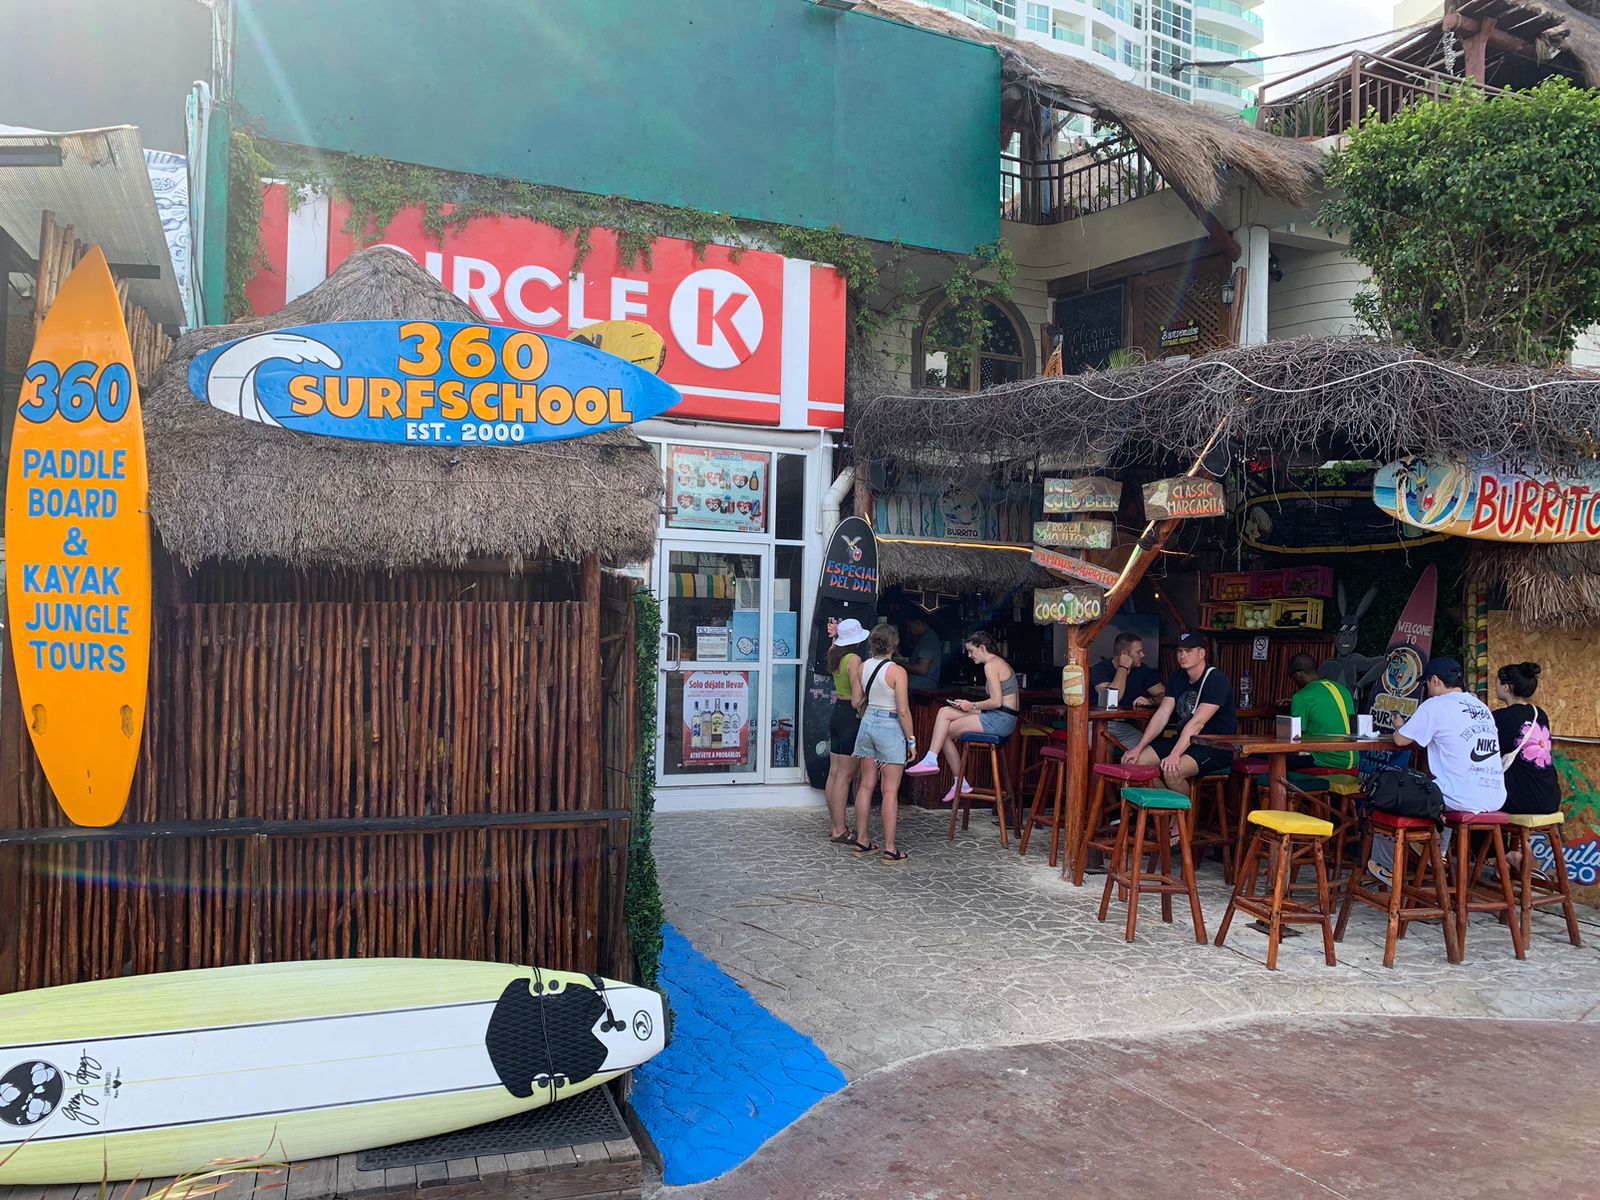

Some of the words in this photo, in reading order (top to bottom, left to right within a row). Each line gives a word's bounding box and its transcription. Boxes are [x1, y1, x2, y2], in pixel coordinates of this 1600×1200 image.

[366, 244, 649, 331] RCLE
[696, 286, 751, 366] K
[397, 321, 549, 381] 360
[18, 360, 131, 424] 360
[287, 375, 633, 425] SURFSCHOOL
[405, 422, 451, 441] EST.
[461, 422, 525, 442] 2000
[22, 449, 127, 480] PADDLE
[1048, 479, 1073, 493] ICE
[1172, 482, 1214, 499] CLASSIC
[28, 487, 118, 519] BOARD
[1044, 494, 1080, 508] COLD
[1084, 494, 1120, 508] BEER
[1167, 497, 1225, 516] MARGARITA
[946, 527, 979, 537] BURRITO
[1046, 521, 1080, 533] FROZEN
[62, 526, 89, 557] &
[826, 559, 877, 582] ESPECIAL
[1036, 551, 1073, 573] FAMOUS
[22, 564, 121, 595] KAYAK
[830, 573, 849, 590] DEL
[852, 578, 871, 593] DIA
[24, 603, 130, 635] JUNGLE
[1035, 602, 1066, 620] COCO
[1070, 600, 1100, 619] LOCO
[1398, 620, 1432, 637] WELCOME
[1406, 633, 1417, 645] TO
[29, 640, 126, 673] TOURS
[689, 680, 703, 689] Solo
[704, 680, 725, 690] déjate
[726, 680, 744, 689] llevar
[1375, 694, 1416, 715] SURFIN
[1476, 738, 1497, 752] NIKE
